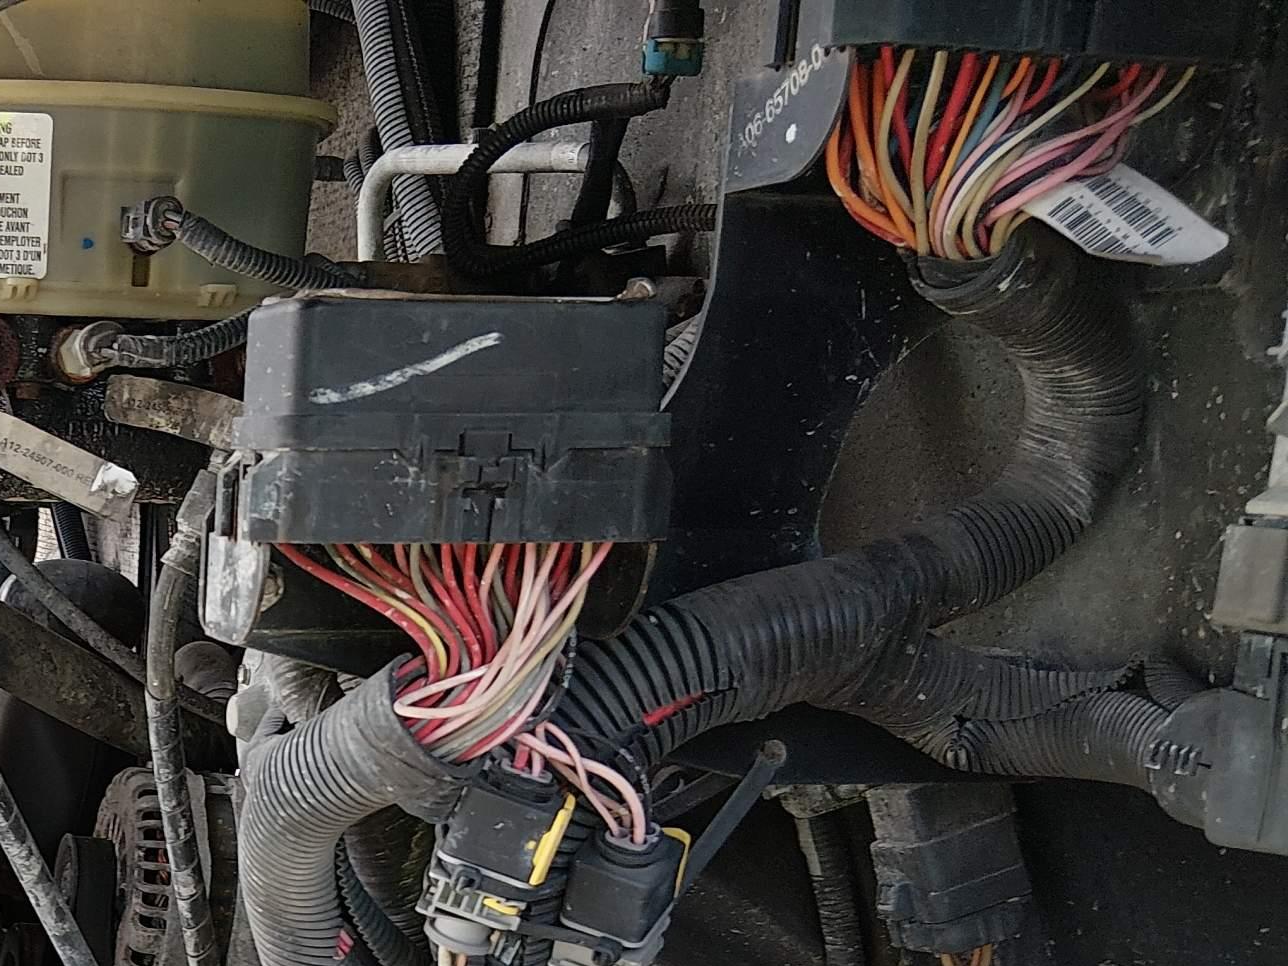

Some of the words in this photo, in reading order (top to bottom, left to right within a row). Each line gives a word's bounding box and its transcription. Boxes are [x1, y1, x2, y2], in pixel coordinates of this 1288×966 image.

[737, 43, 822, 155] 06-65708-0
[11, 137, 41, 149] BEFORE
[0, 151, 19, 162] ONLY
[21, 152, 37, 163] DOT
[38, 152, 44, 163] 3
[5, 221, 30, 233] AVANT
[15, 250, 21, 261] 3
[23, 250, 42, 262] D'UN
